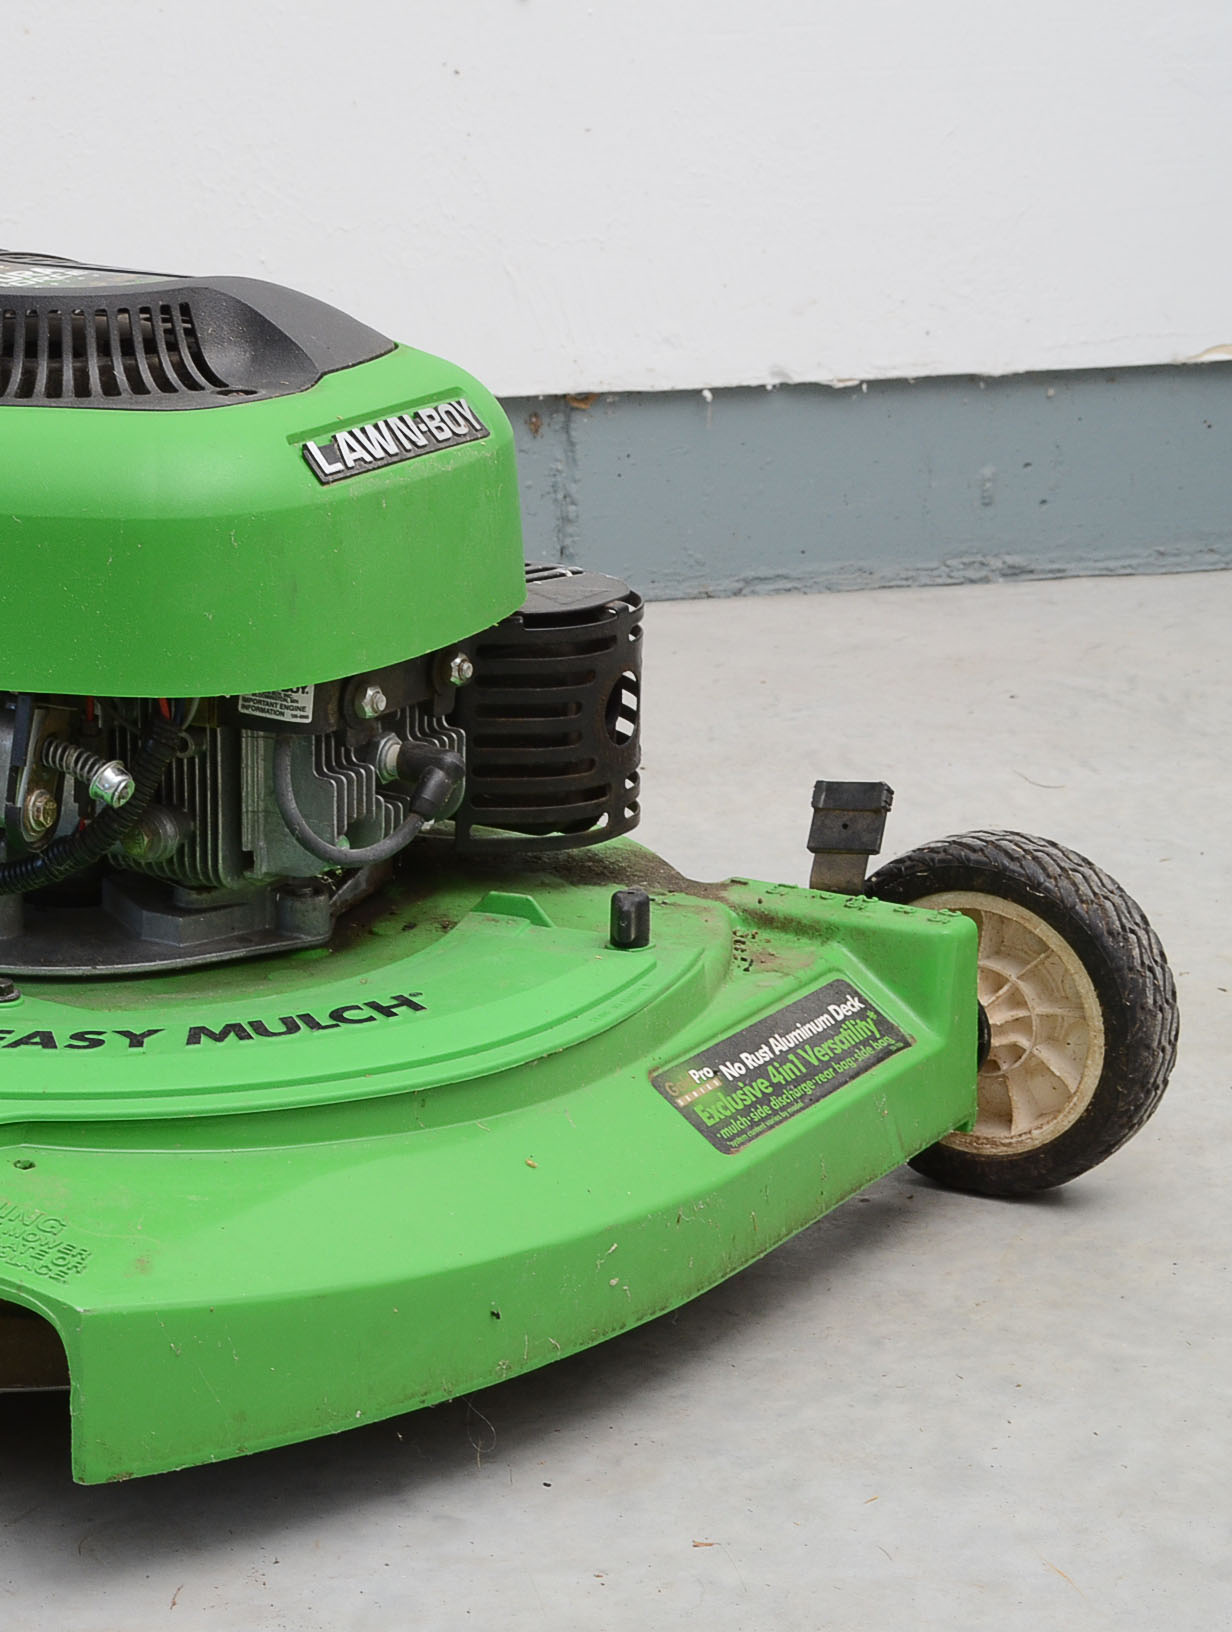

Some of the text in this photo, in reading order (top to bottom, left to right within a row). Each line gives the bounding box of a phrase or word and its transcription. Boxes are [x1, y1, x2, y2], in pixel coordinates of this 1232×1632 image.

[303, 398, 482, 475] LAWN-BOY
[241, 697, 278, 708] IMPORTANT
[241, 703, 285, 717] INFORMATION
[719, 994, 865, 1081] No Rust Aluminum Deck
[688, 1067, 714, 1084] Pro
[694, 1078, 773, 1126] Exclusive
[1, 1228, 93, 1261] MOWER
[51, 1253, 88, 1274] OR
